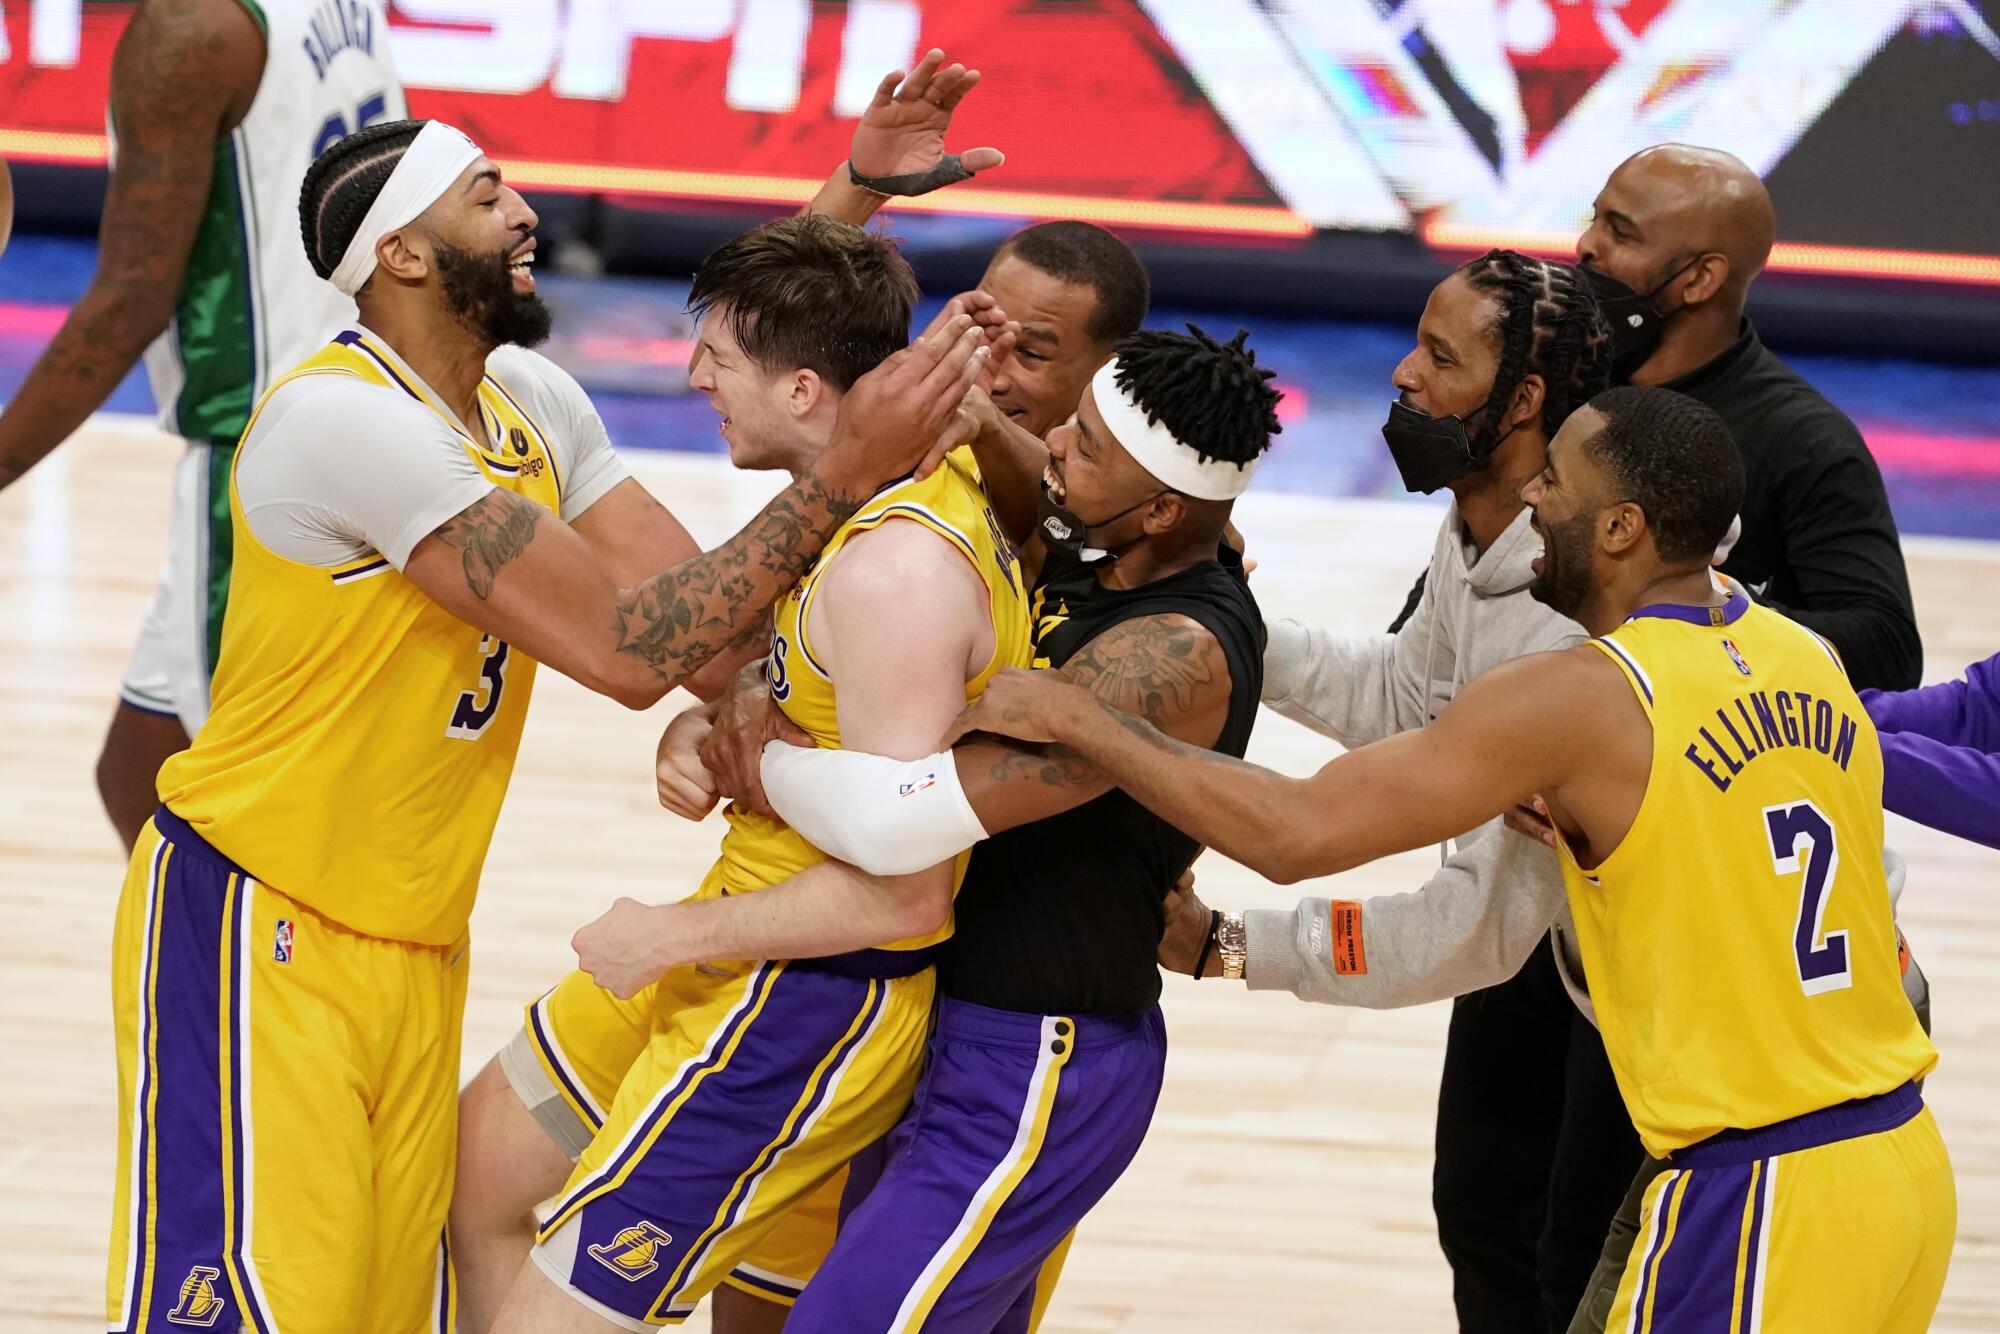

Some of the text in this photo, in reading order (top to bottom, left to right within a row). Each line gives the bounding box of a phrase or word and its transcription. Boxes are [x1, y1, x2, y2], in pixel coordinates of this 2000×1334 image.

[445, 632, 511, 741] 3
[1684, 690, 1857, 793] ELLINGTON
[1761, 798, 1854, 997] 2
[1347, 938, 1357, 971] PRESTON
